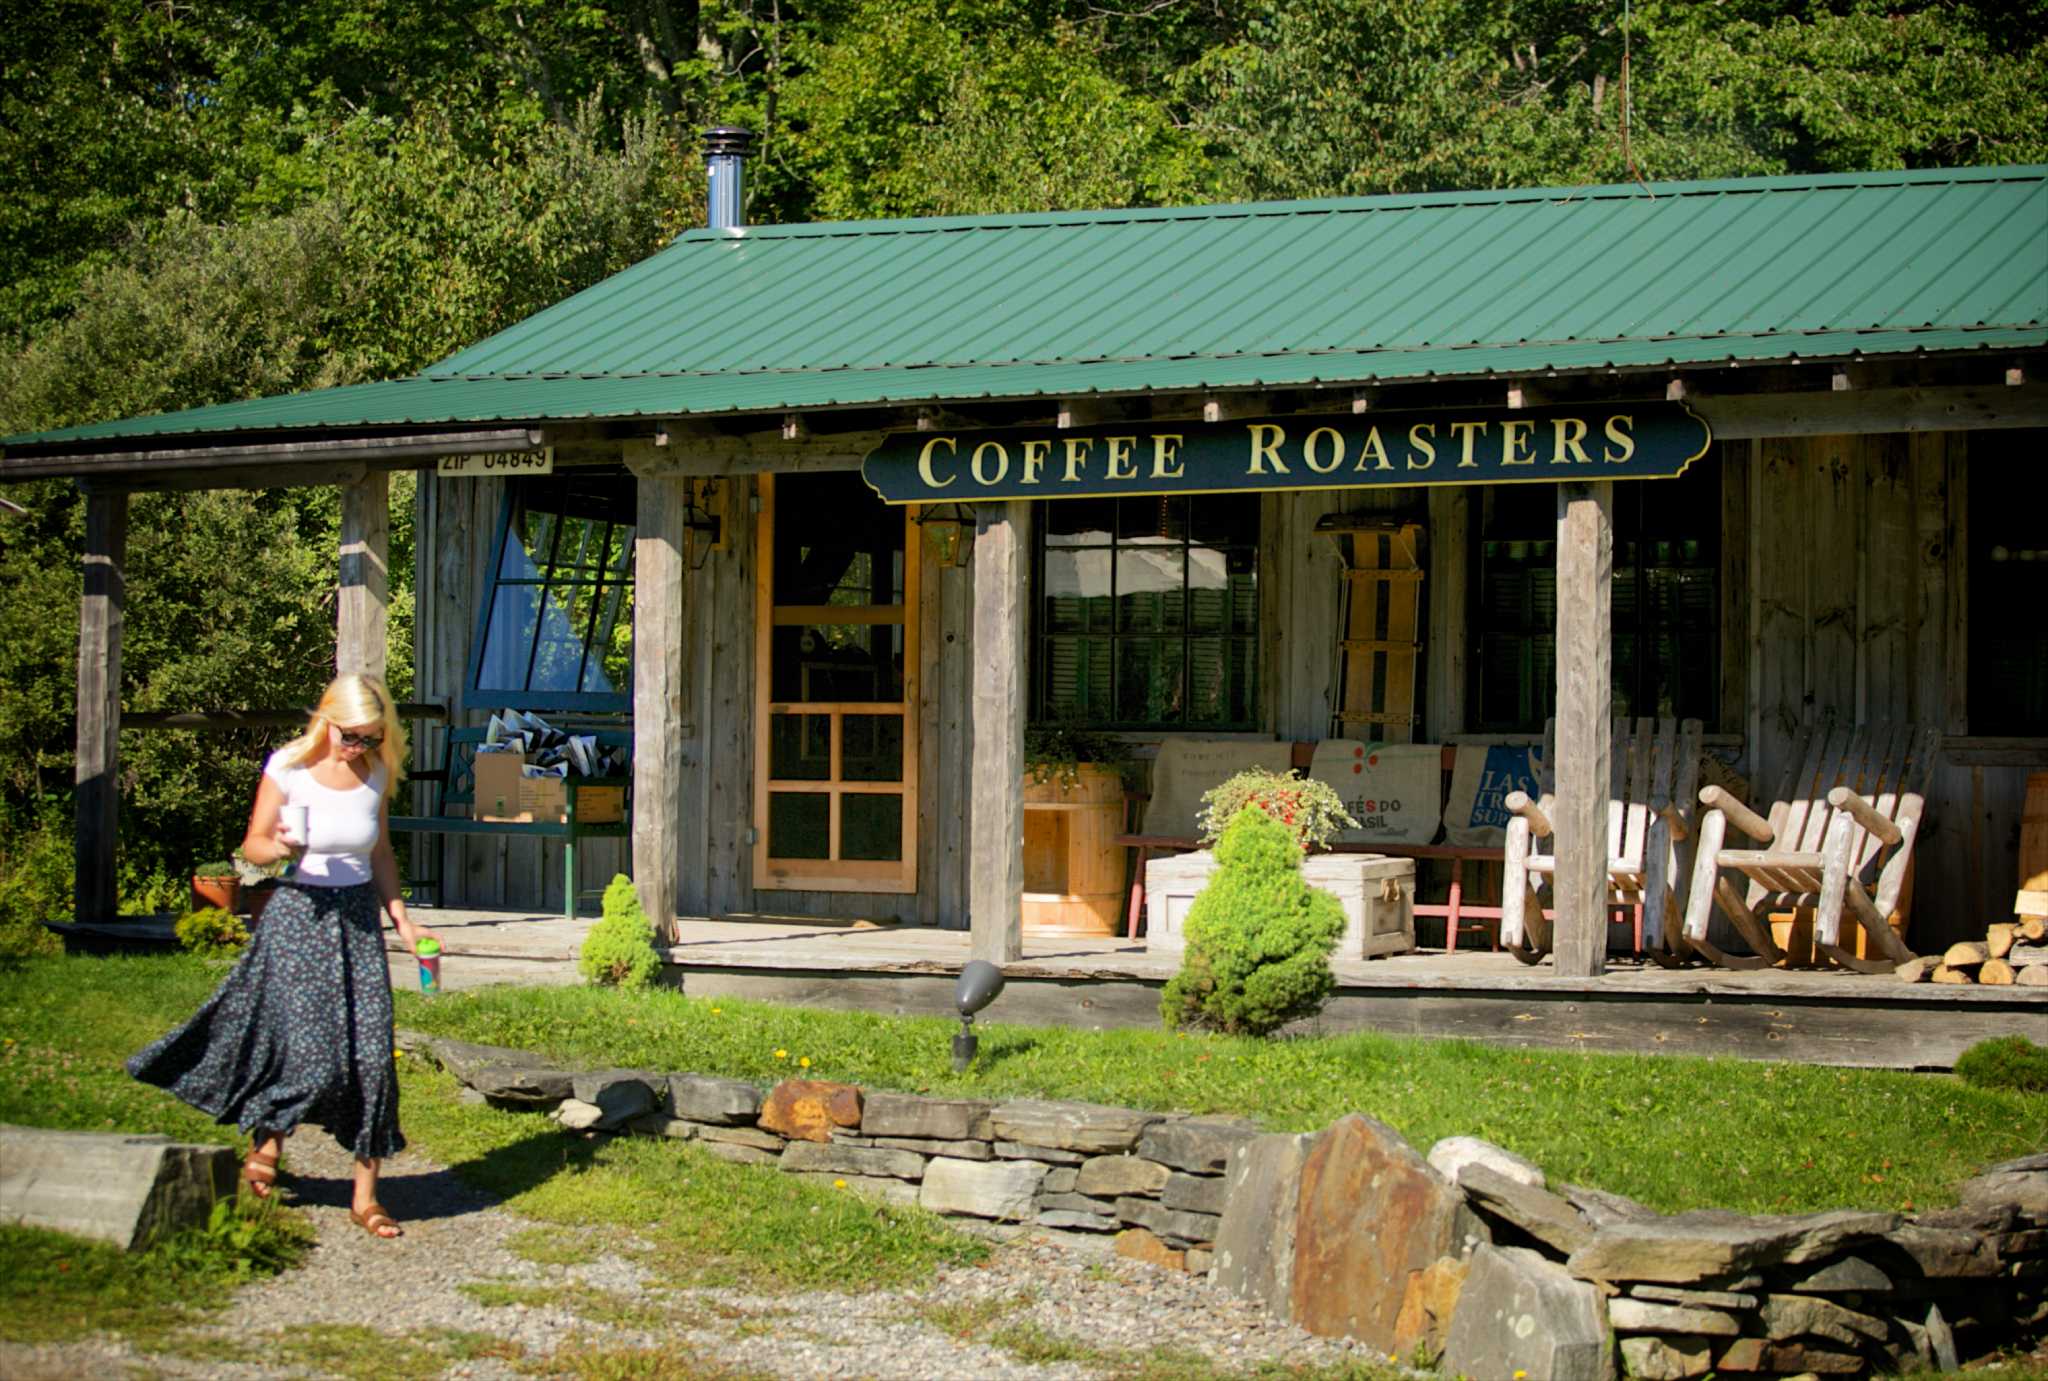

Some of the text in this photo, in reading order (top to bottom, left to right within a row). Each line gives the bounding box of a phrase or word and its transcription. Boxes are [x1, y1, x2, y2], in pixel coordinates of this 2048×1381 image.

[442, 450, 547, 470] ZIP 04849
[917, 415, 1636, 488] COFFEE ROASTERS
[1342, 795, 1402, 814] FÉS DO
